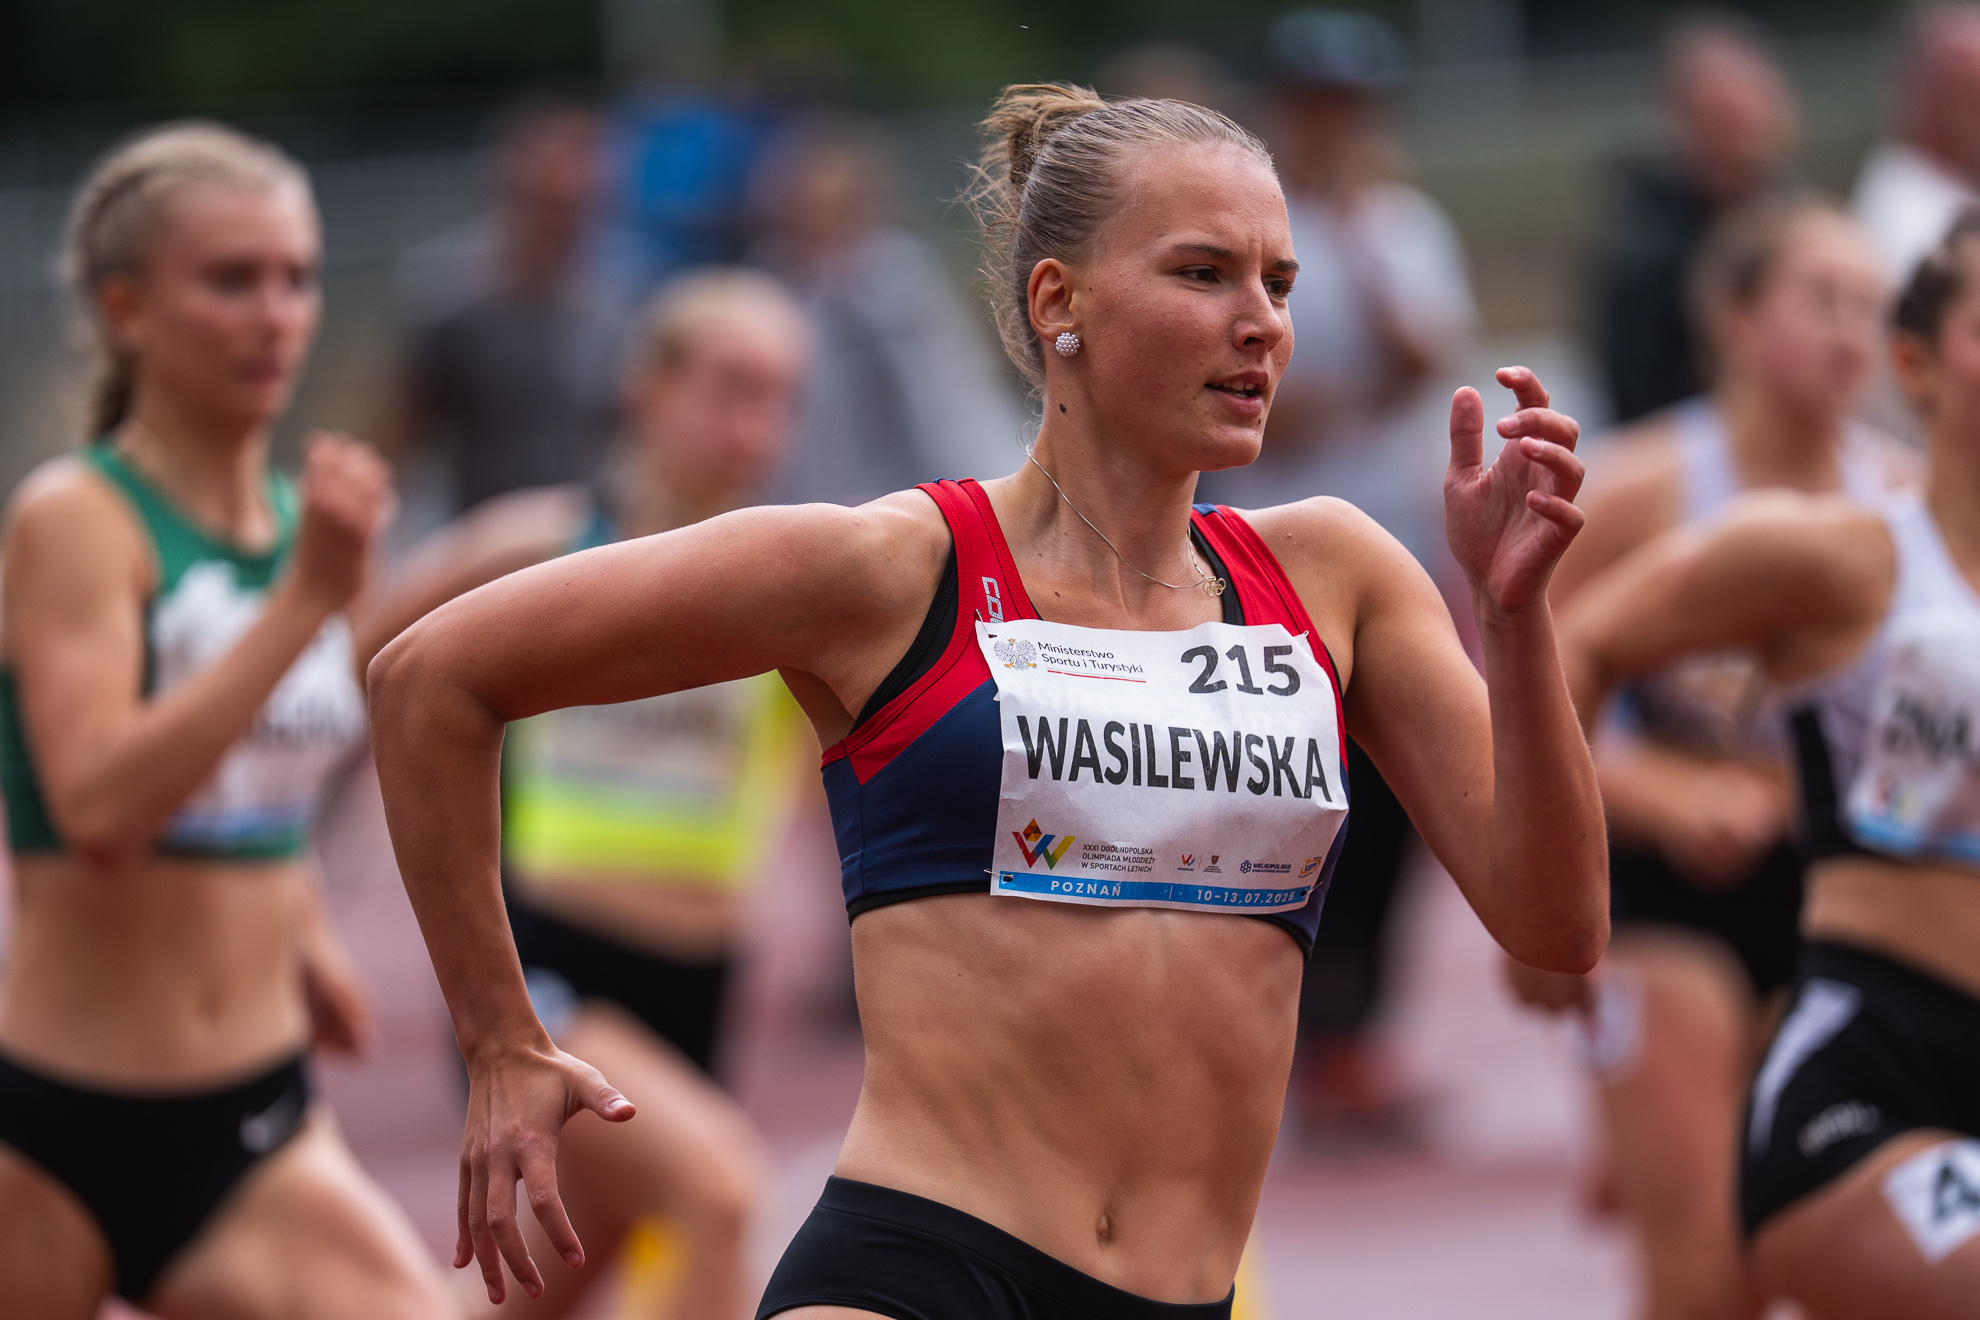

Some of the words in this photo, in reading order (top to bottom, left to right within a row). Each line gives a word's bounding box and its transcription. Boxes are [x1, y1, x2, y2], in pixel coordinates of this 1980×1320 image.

[1037, 641, 1114, 659] Ministerstwo
[1041, 653, 1082, 670] Sportu
[1083, 658, 1088, 668] i
[1088, 659, 1144, 674] Turystyki
[1181, 644, 1301, 696] 215
[1016, 715, 1333, 803] WASILEWSKA
[1082, 844, 1099, 852] XXXI
[1100, 845, 1154, 855] OGÓLNOPOLSKA
[1082, 852, 1121, 862] OLIMPIADA
[1122, 856, 1156, 864] MŁODZIEŻY
[1090, 862, 1127, 871] SPORTACH
[1127, 865, 1153, 873] LETNICH
[1051, 880, 1122, 897] POZNAŃ
